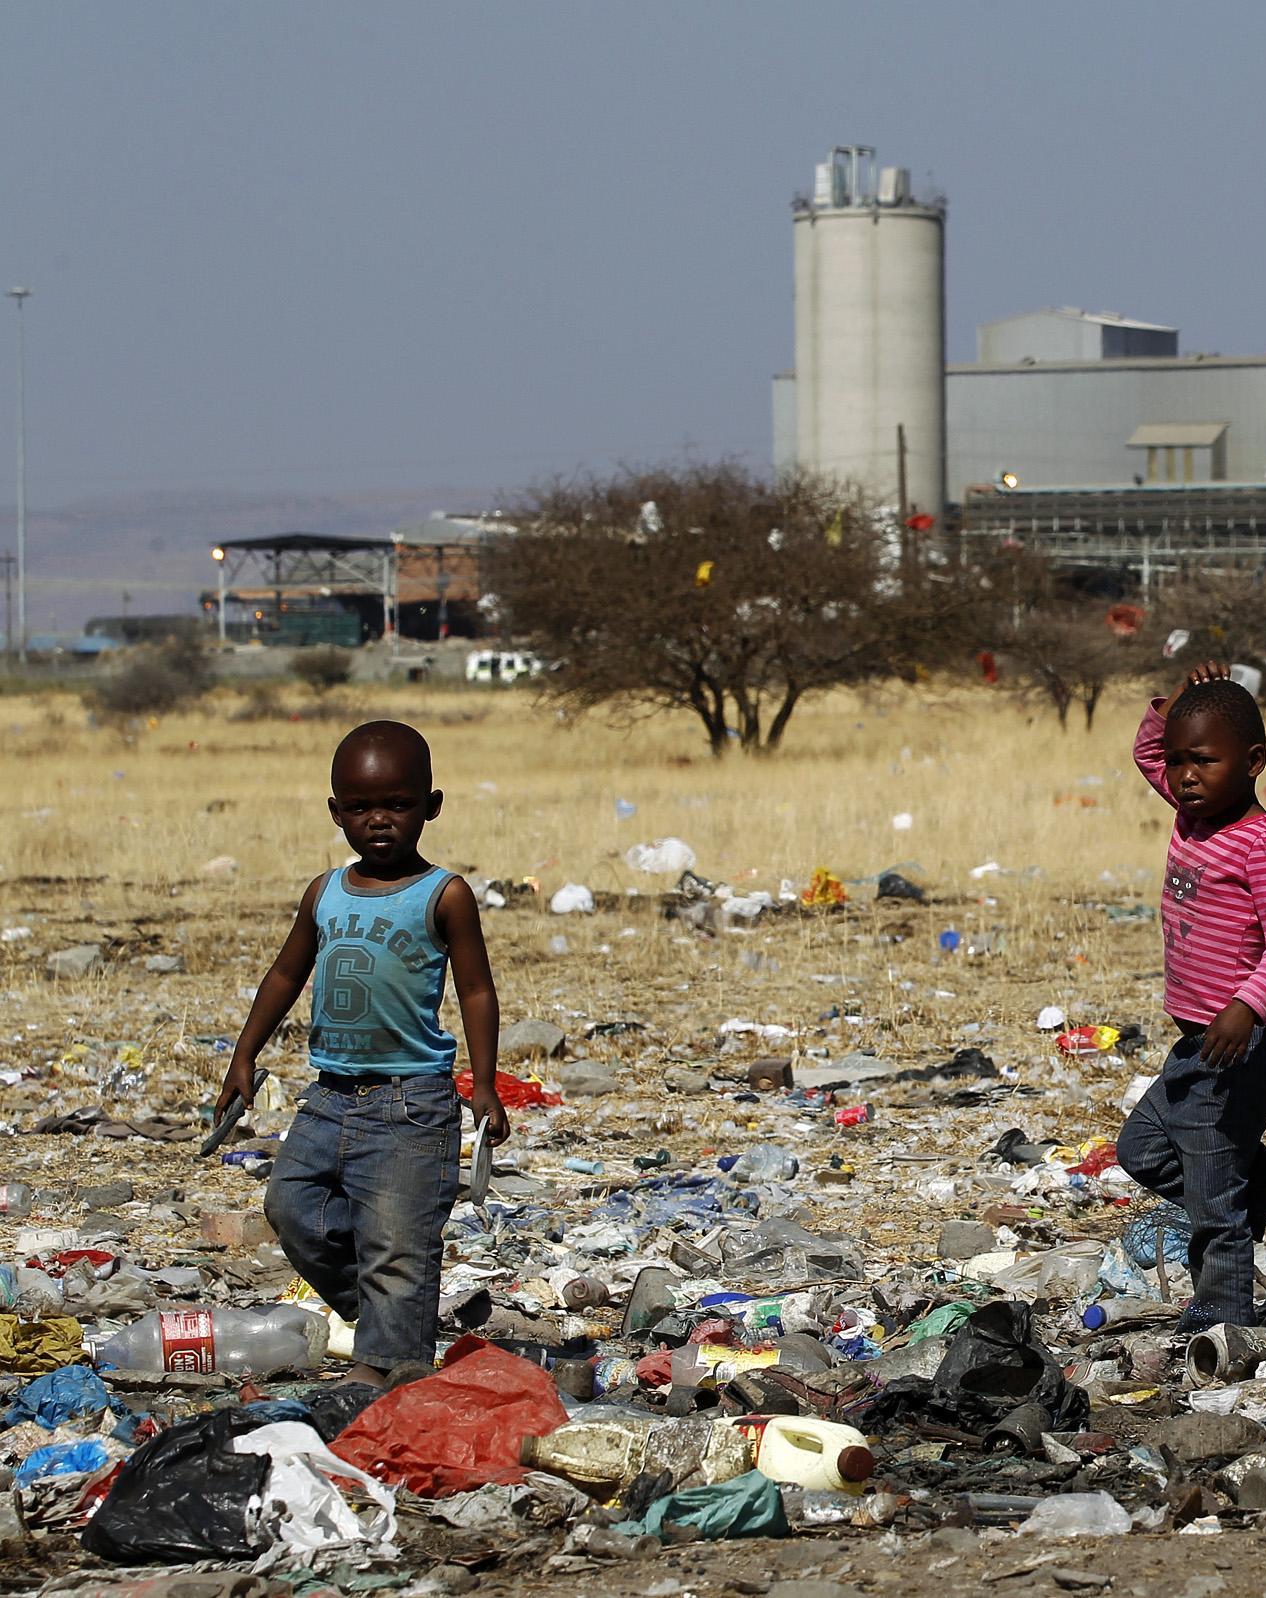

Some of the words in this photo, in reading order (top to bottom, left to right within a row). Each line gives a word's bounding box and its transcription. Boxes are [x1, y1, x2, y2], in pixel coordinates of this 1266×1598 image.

[317, 913, 432, 973] OLLEGE
[320, 944, 376, 1024] 6
[320, 1032, 371, 1050] TEAM
[174, 1358, 185, 1372] ON
[185, 1354, 195, 1372] EW
